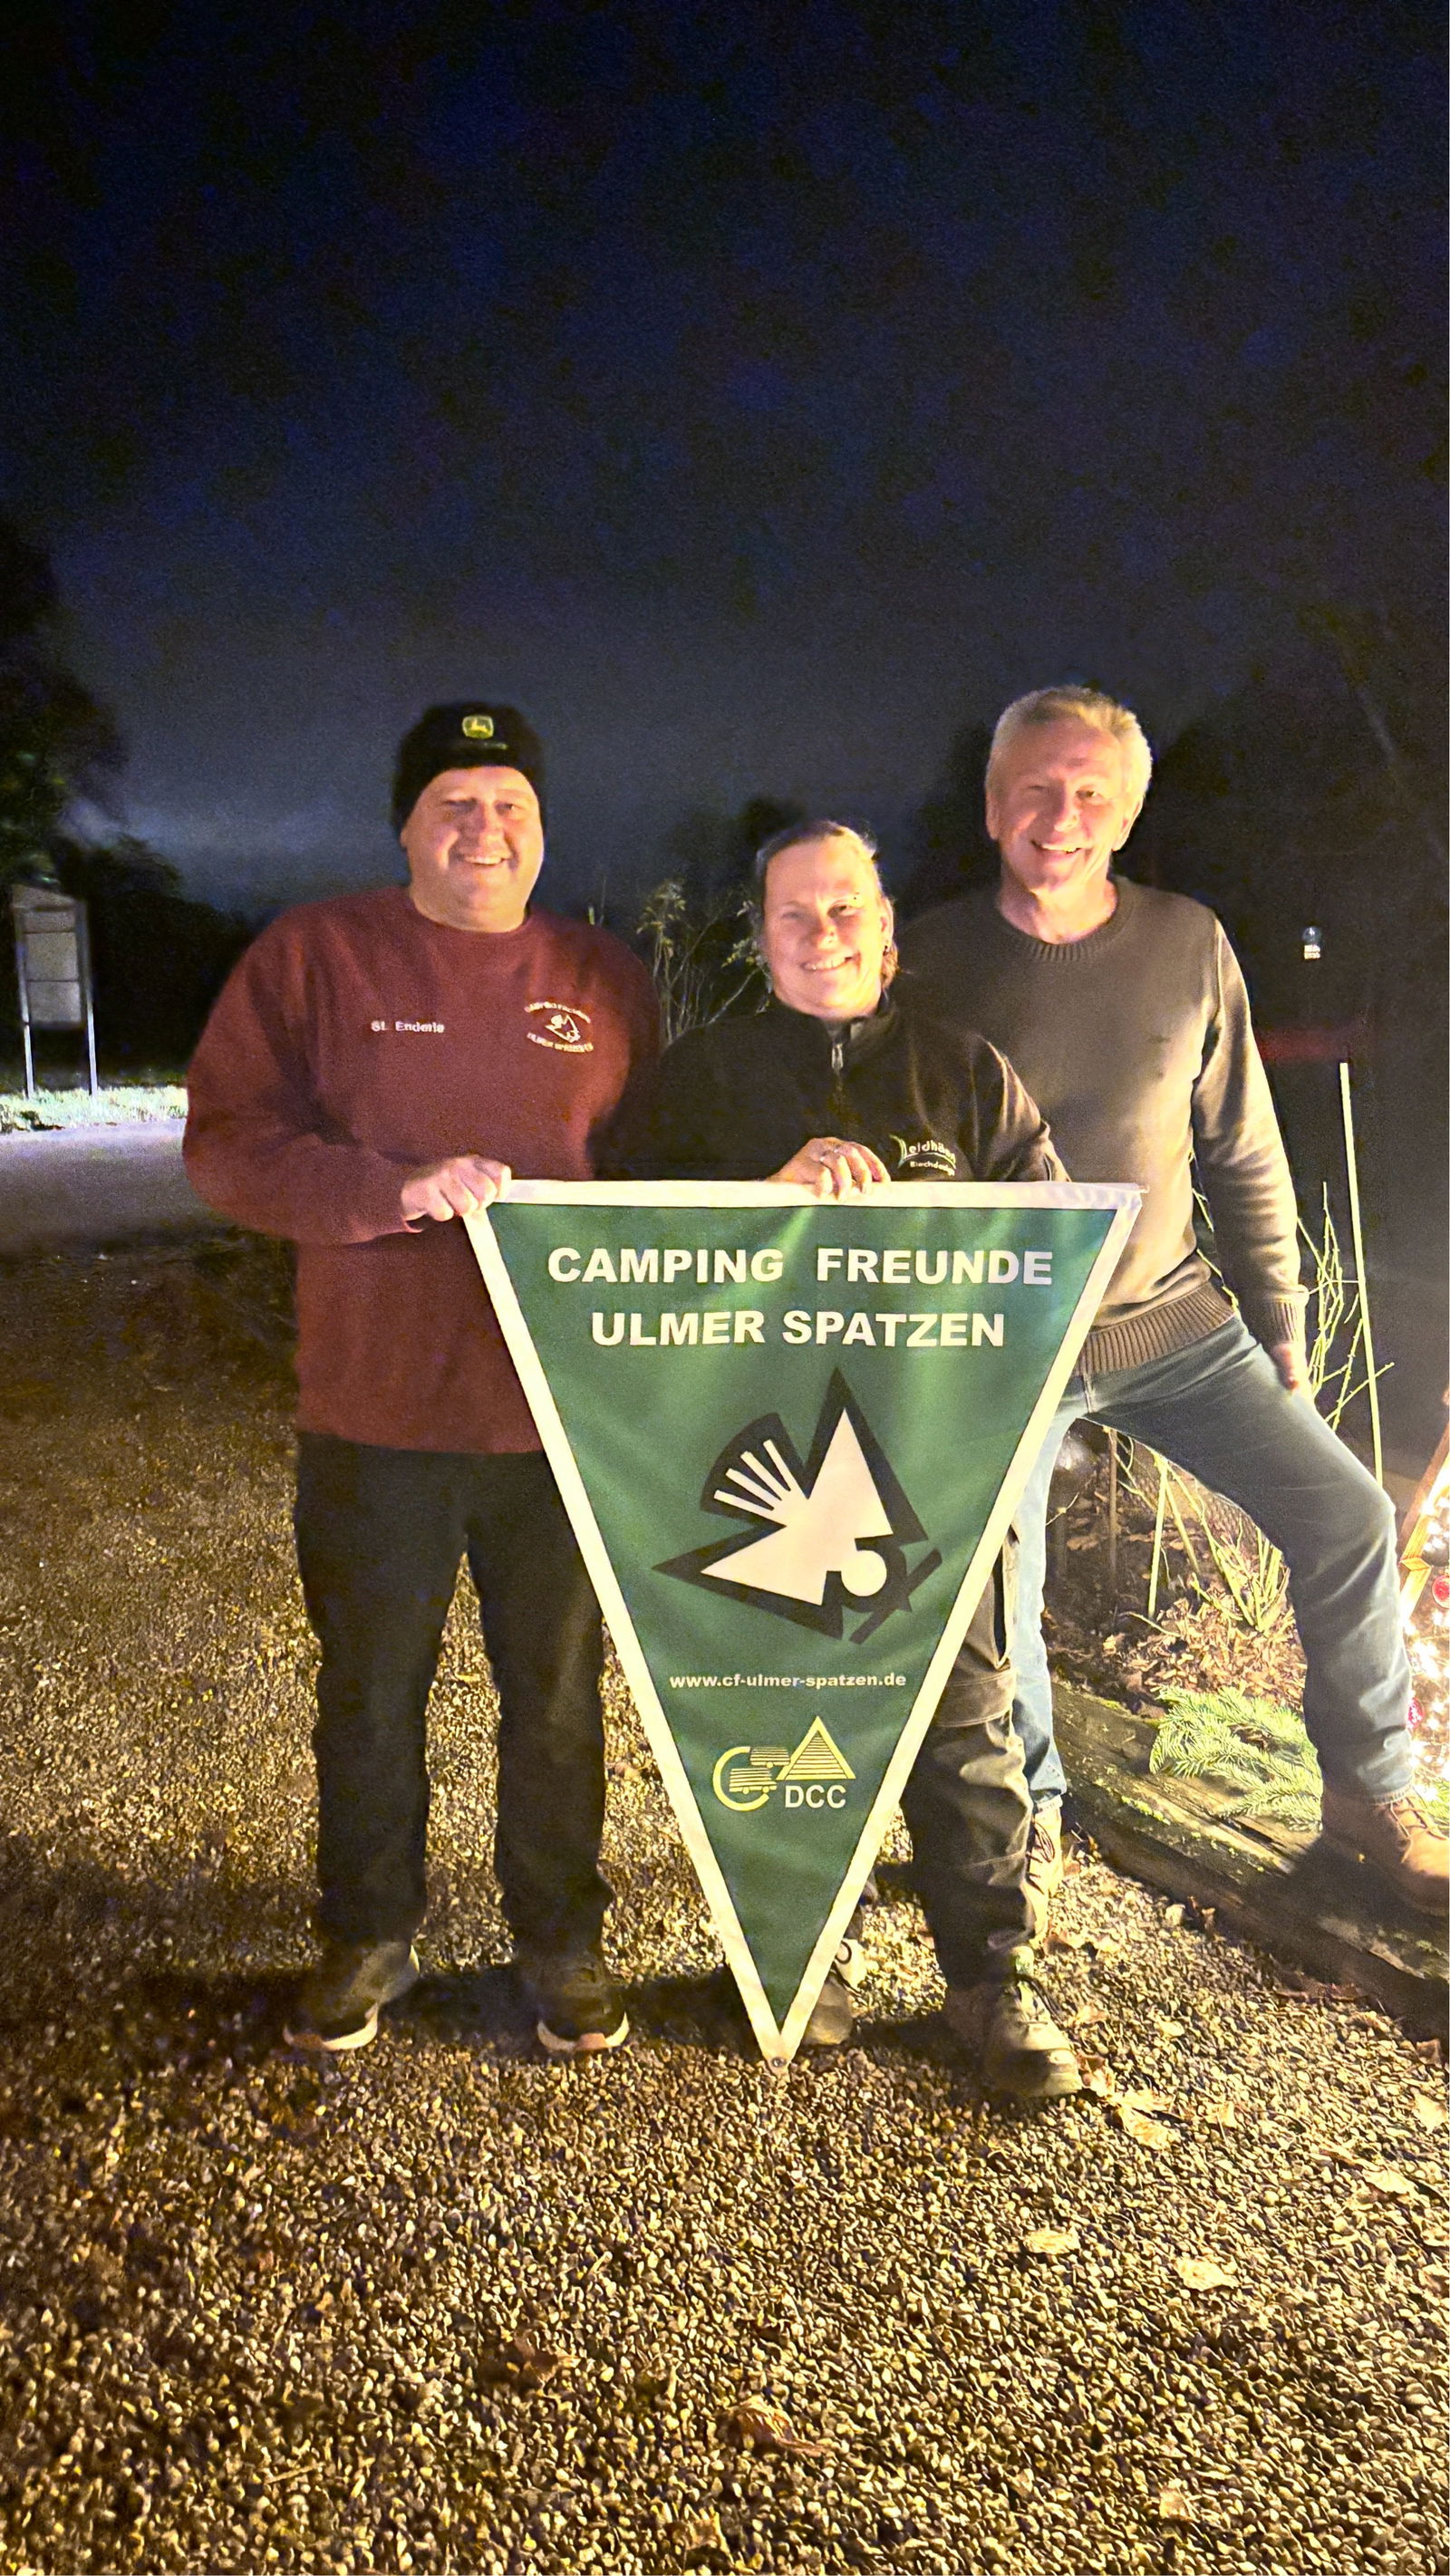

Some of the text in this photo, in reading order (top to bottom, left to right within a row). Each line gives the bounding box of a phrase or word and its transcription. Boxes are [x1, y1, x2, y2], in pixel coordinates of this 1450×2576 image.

[547, 1247, 1053, 1286] CAMPING FREUNDE
[591, 1310, 1004, 1347] ULMER SPATZEN
[669, 1672, 907, 1690] www.cf-ulmer-spatzen.de
[785, 1784, 846, 1809] DCC
